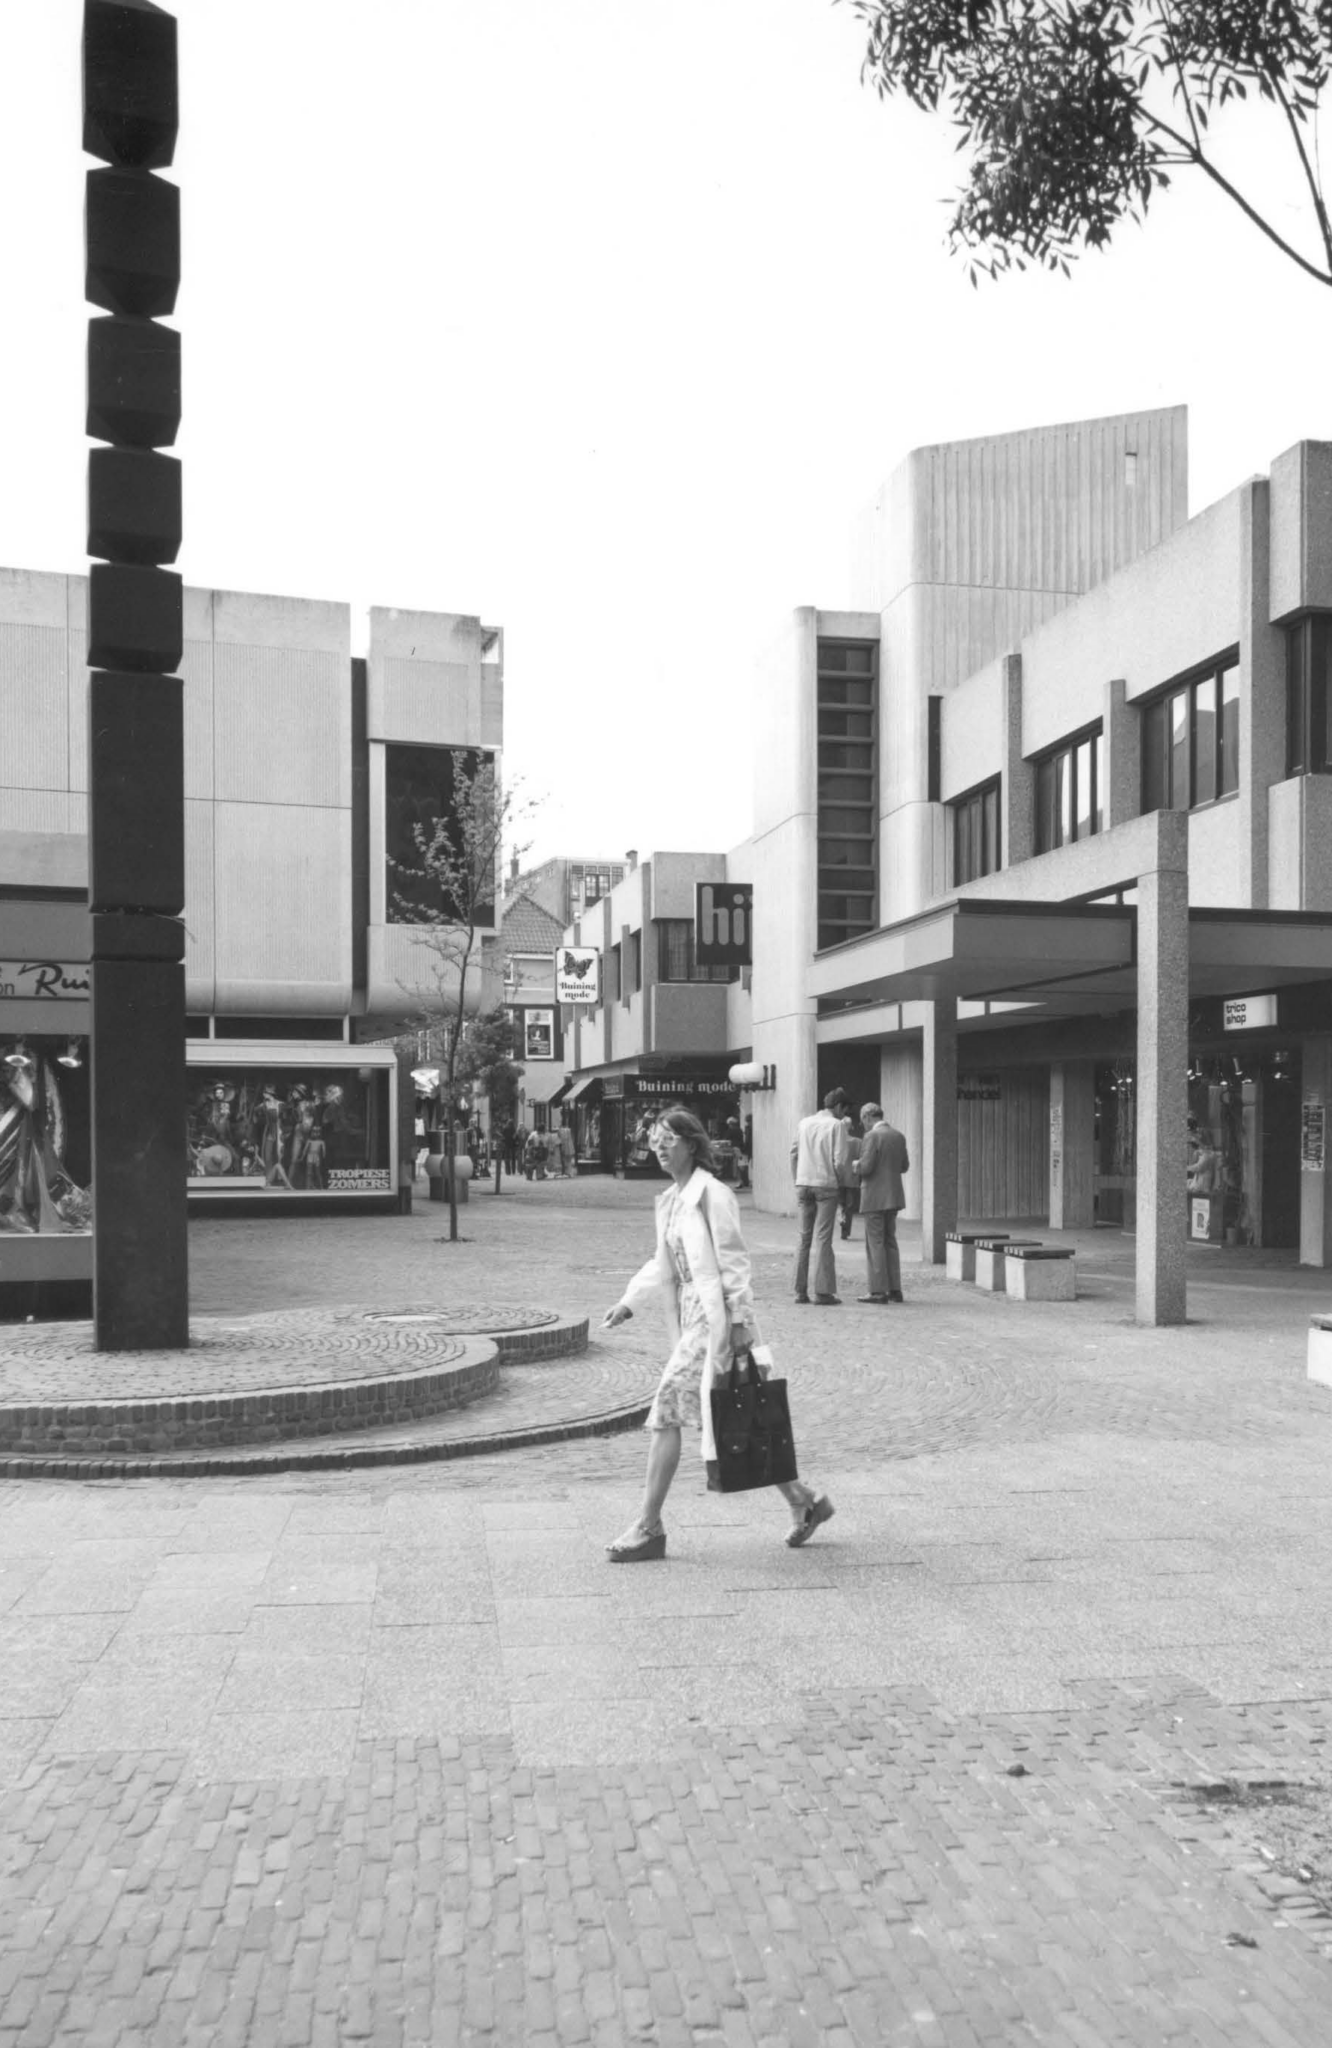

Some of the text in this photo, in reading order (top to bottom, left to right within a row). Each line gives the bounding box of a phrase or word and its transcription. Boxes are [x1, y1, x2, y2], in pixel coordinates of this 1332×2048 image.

[558, 982, 596, 991] Buining
[565, 991, 590, 1000] mode
[1226, 1002, 1247, 1014] trico
[1226, 1014, 1247, 1026] shop
[636, 1080, 694, 1094] Buining
[698, 1081, 736, 1094] mode
[328, 1169, 390, 1179] TROPIESE
[328, 1179, 390, 1189] ZOMERS
